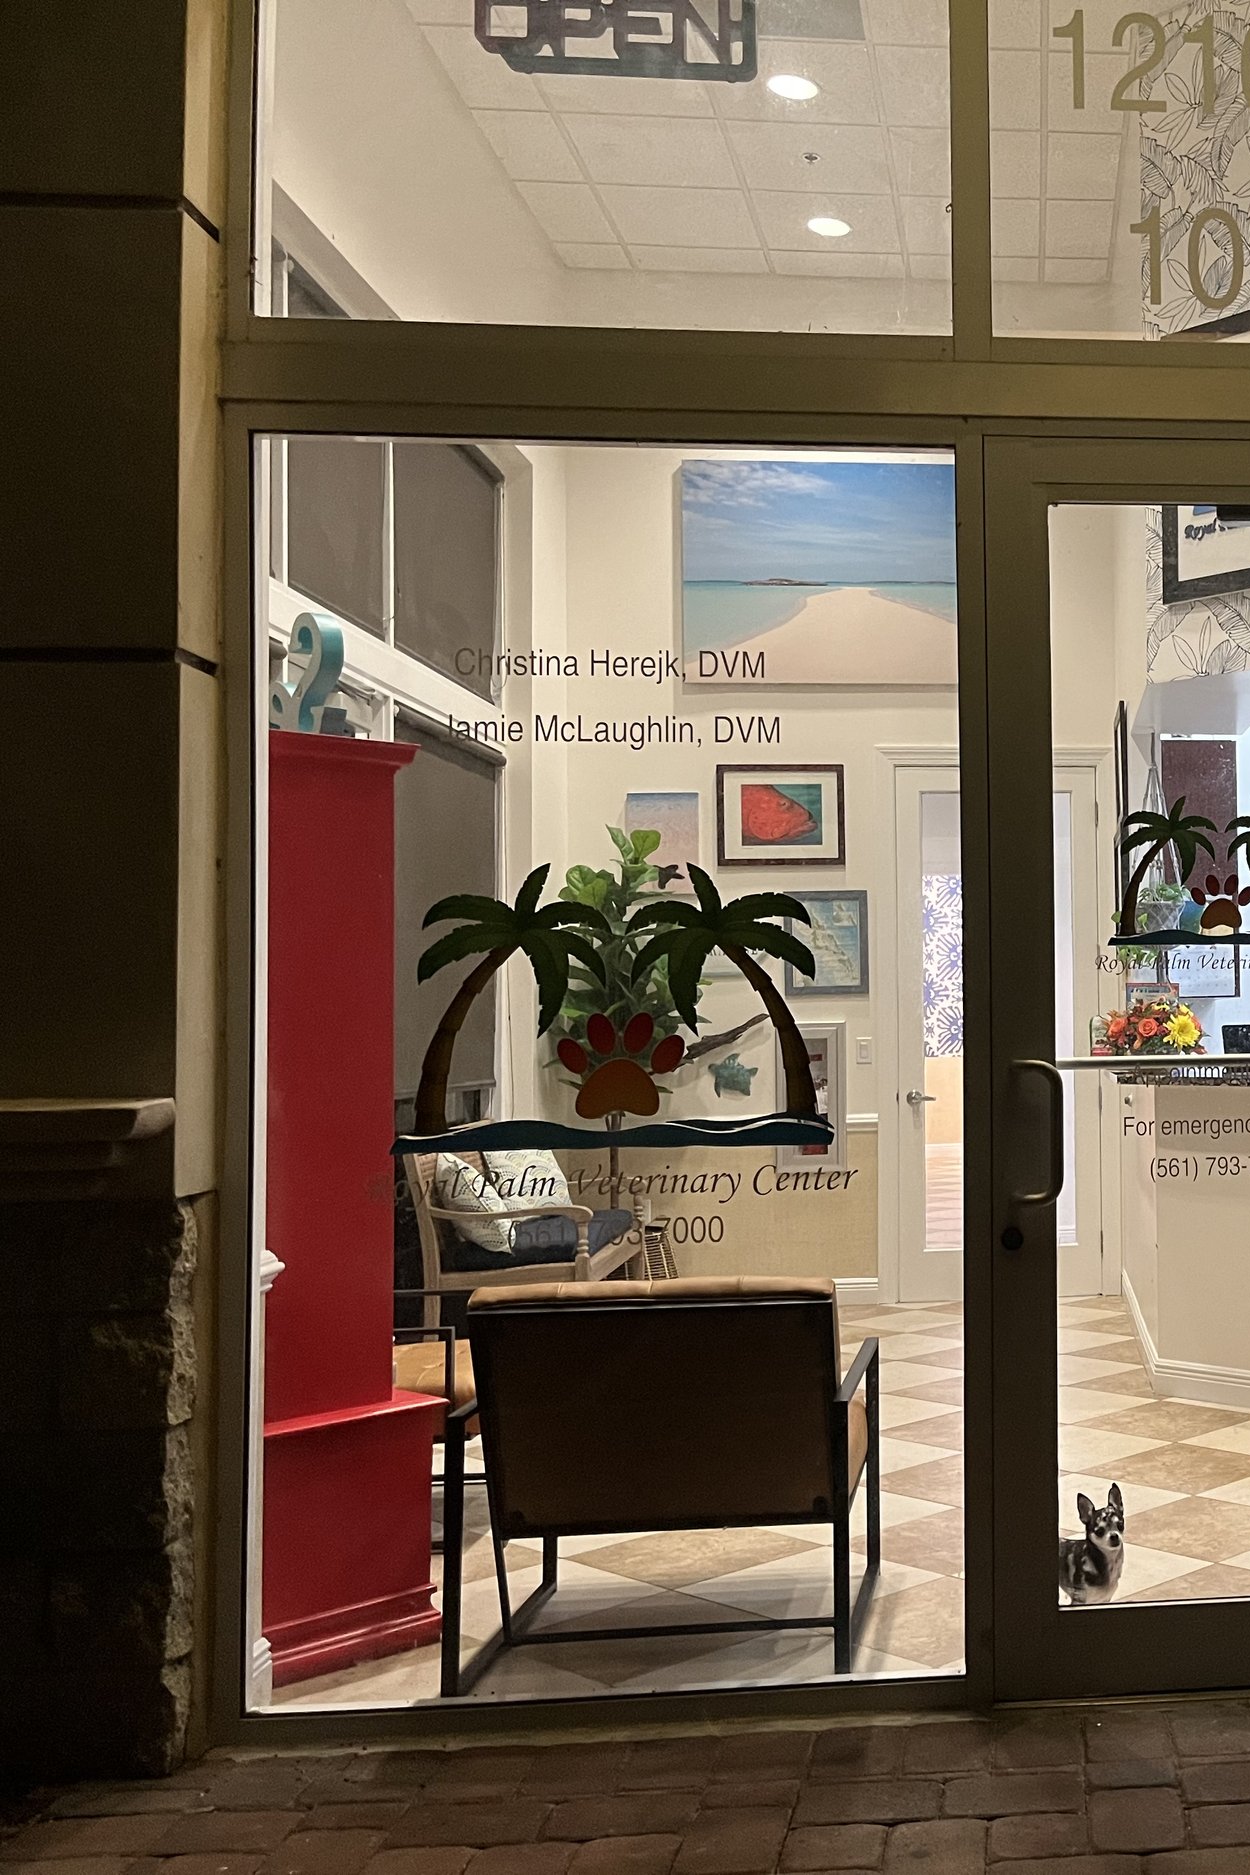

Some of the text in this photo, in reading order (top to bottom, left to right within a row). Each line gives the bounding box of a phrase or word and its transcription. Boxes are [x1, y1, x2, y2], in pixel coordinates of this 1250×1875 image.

[476, 0, 737, 65] OPEN
[454, 648, 765, 684] Christina Herejk, DVM
[535, 715, 702, 750] McLaughlin,
[715, 716, 781, 743] DVM
[1123, 1116, 1154, 1137] For
[472, 1164, 556, 1199] Palm
[569, 1163, 742, 1204] Veterinary
[752, 1164, 859, 1196] Center
[1150, 1156, 1199, 1183] (561)
